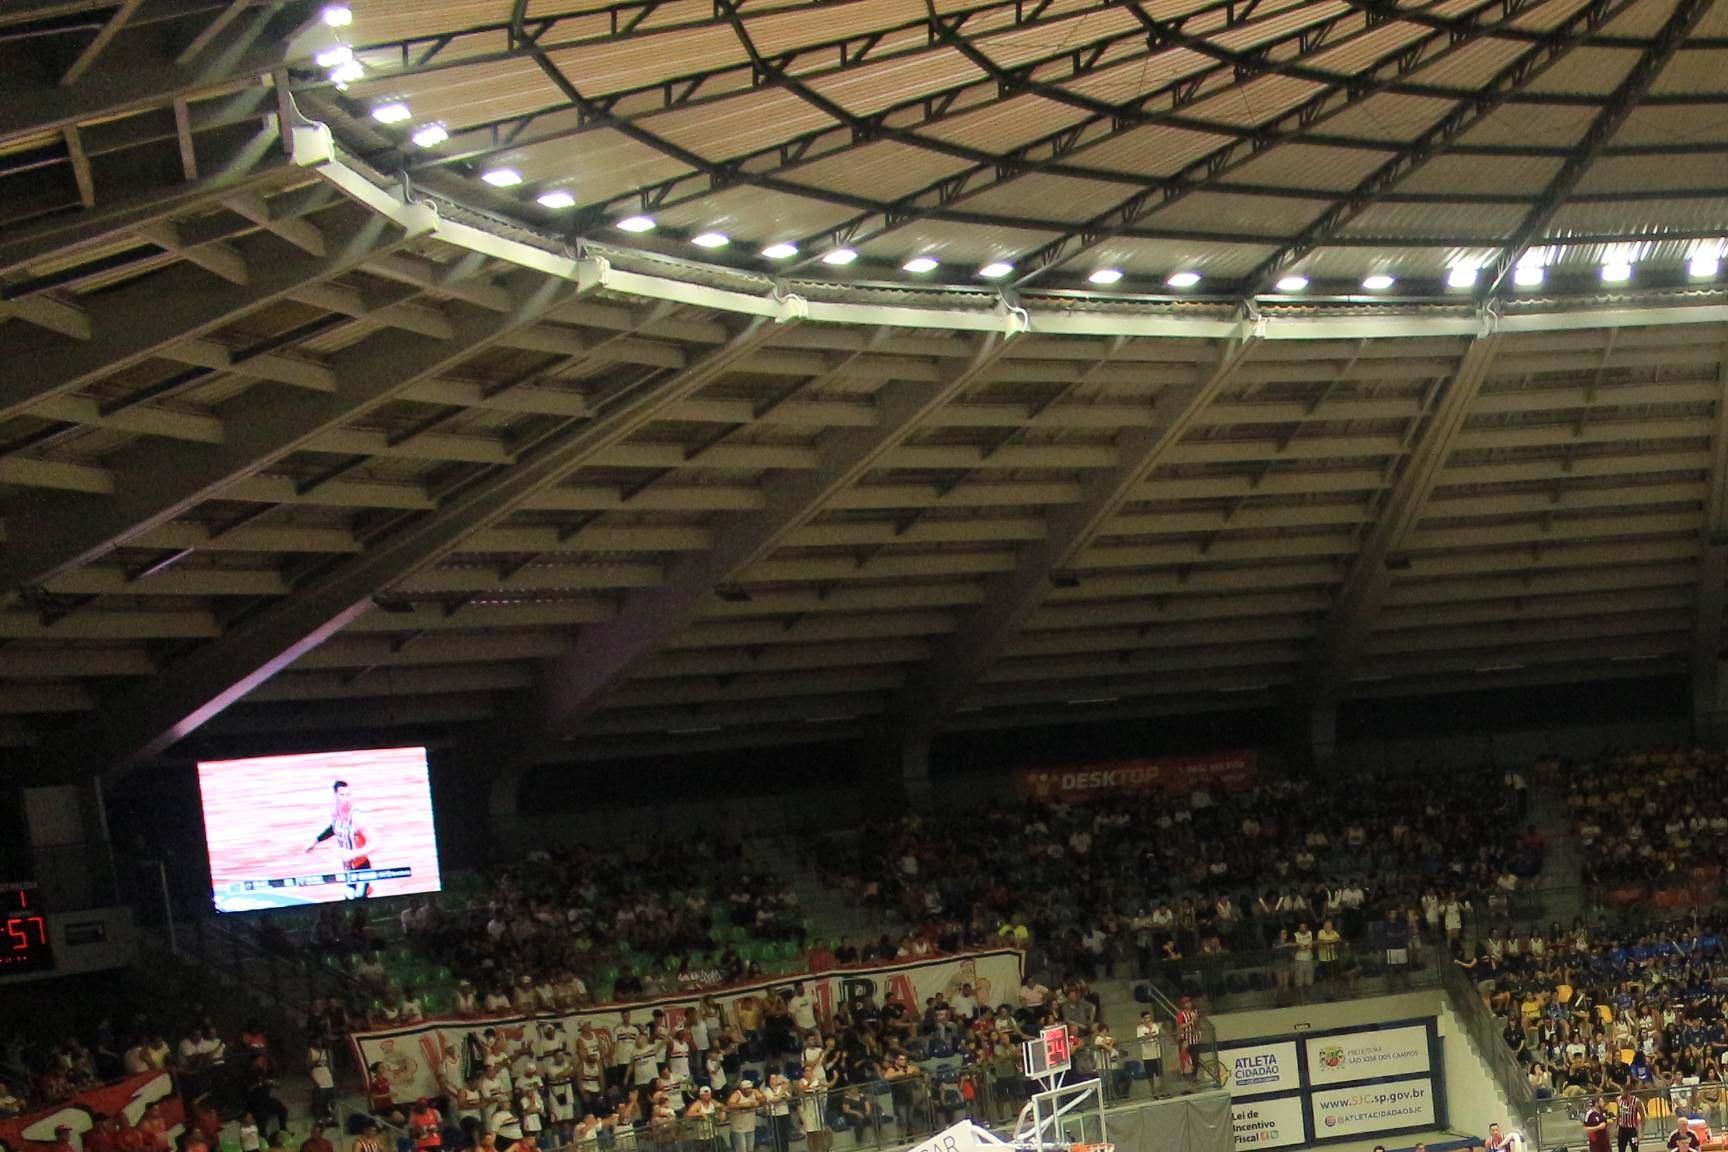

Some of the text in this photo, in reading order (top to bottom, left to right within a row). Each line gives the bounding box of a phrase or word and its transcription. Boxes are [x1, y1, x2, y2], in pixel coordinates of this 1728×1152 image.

[1061, 766, 1160, 790] DESKTOP
[1234, 1054, 1278, 1070] ATLETA
[1320, 1088, 1425, 1109] www.SJC.sp.gov.br
[1246, 1110, 1259, 1119] de
[1232, 1120, 1276, 1132] Incentivo
[1233, 1132, 1260, 1144] Fiscal
